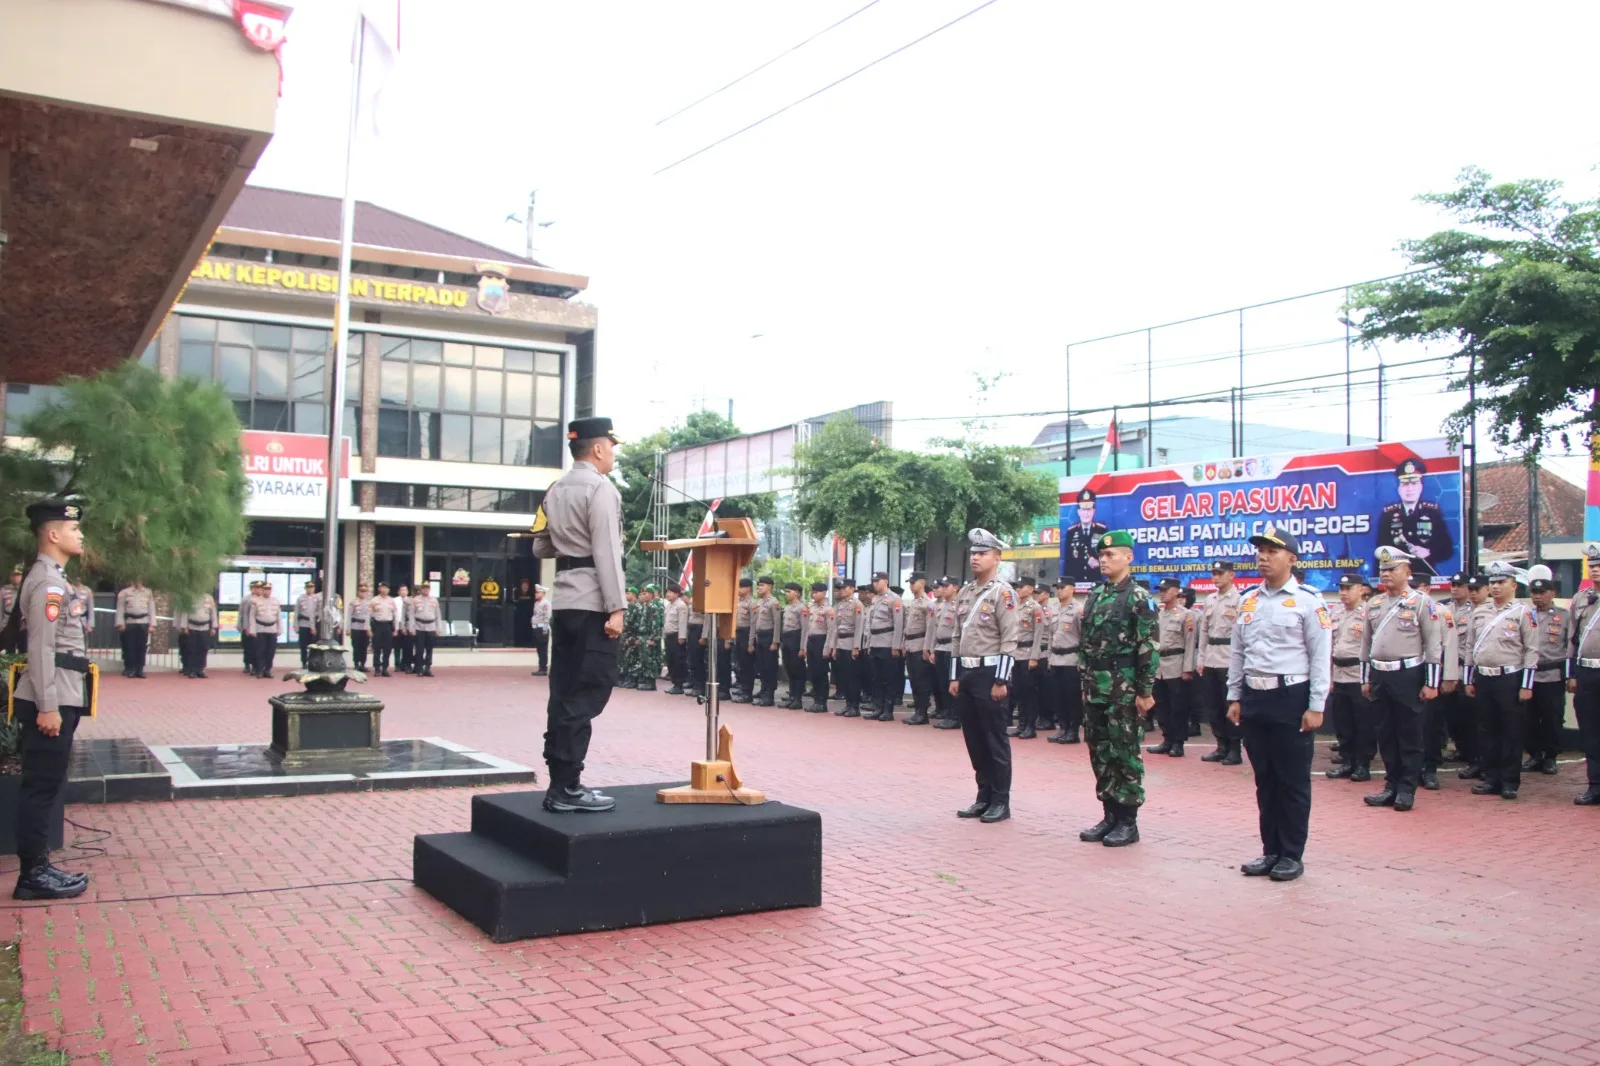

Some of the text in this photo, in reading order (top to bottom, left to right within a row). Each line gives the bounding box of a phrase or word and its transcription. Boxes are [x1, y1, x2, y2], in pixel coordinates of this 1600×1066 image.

[192, 260, 231, 280] AN
[372, 279, 468, 307] TERPADU
[243, 455, 324, 475] LRI UNTUK
[247, 480, 324, 497] SYARAKAT
[1141, 481, 1336, 521] GELAR PASUKAN
[1120, 525, 1184, 543] PERASI
[1190, 522, 1246, 541] PATUH
[1148, 545, 1199, 559] POLRES
[1129, 564, 1147, 574] ERTIB
[1149, 563, 1179, 573] BERLALU
[1181, 562, 1206, 572] LINTAS
